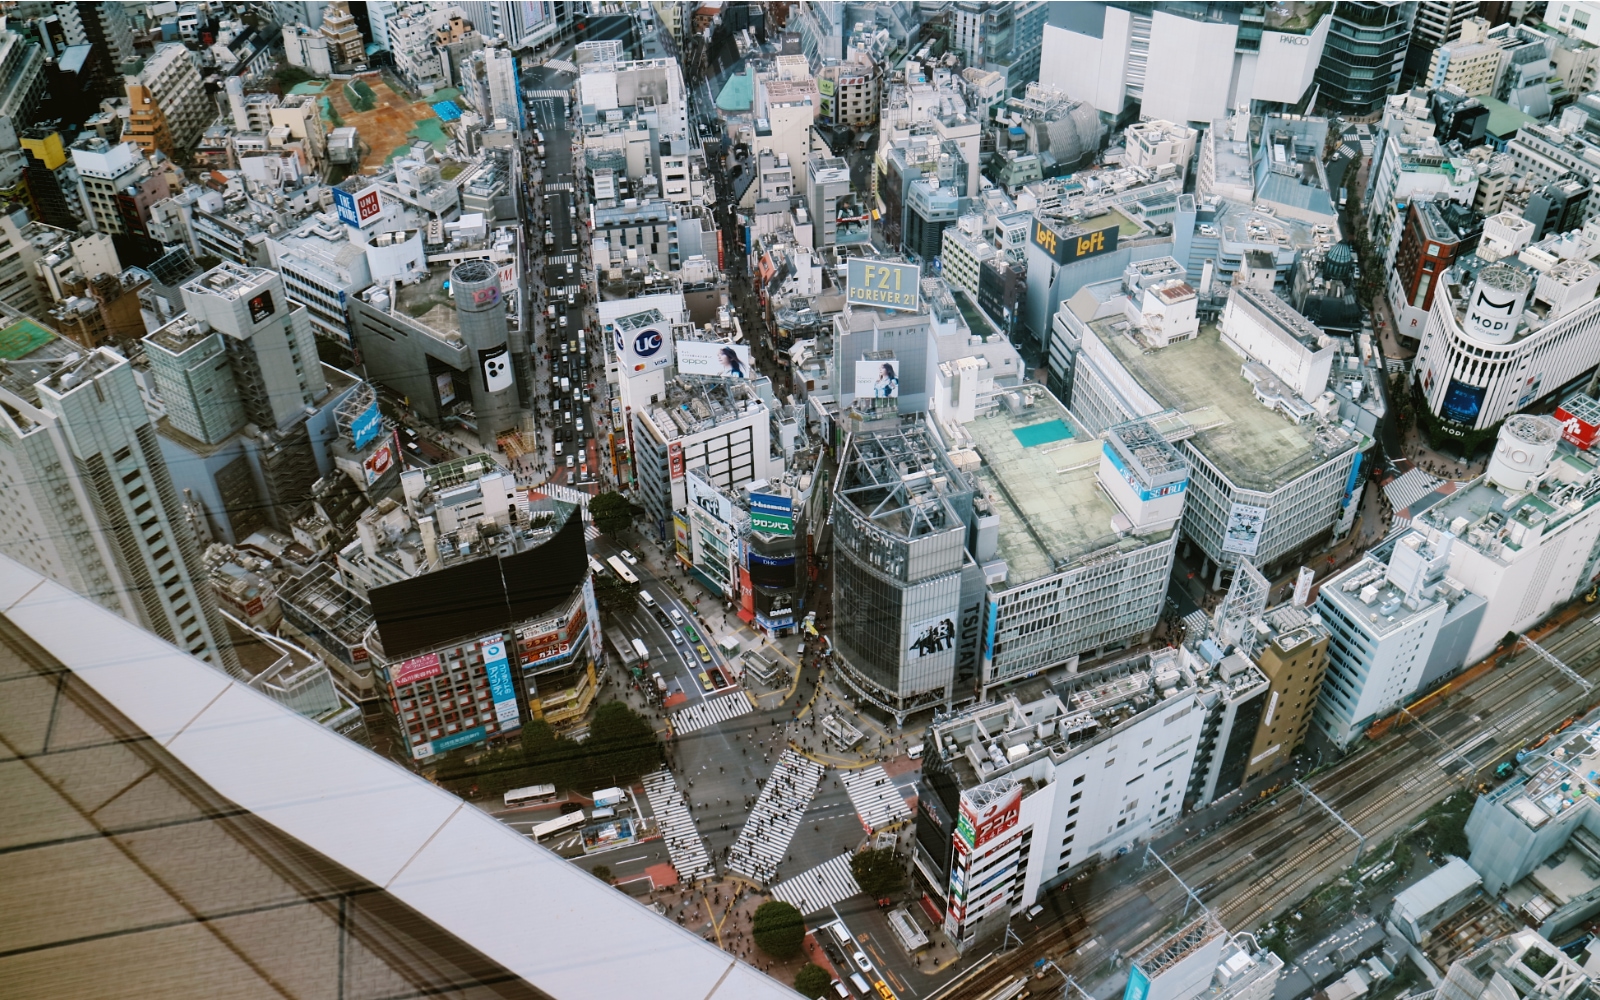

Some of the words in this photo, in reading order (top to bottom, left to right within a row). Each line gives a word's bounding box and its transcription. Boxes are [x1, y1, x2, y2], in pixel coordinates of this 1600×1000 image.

[1280, 35, 1309, 46] PARCO
[338, 193, 351, 209] THE
[360, 195, 375, 208] UNI
[362, 203, 378, 217] QLO
[338, 205, 357, 223] PRIME
[864, 264, 902, 291] F21
[850, 287, 900, 304] FOREVER
[903, 294, 915, 305] 21
[1471, 312, 1509, 331] MODI
[635, 334, 660, 352] UC
[653, 358, 668, 366] VISA
[1441, 426, 1465, 438] MODI
[1150, 484, 1182, 499] SEIBU
[958, 602, 981, 684] TSUTAYA
[488, 665, 503, 697] アイシティ
[980, 809, 1018, 838] アコム
